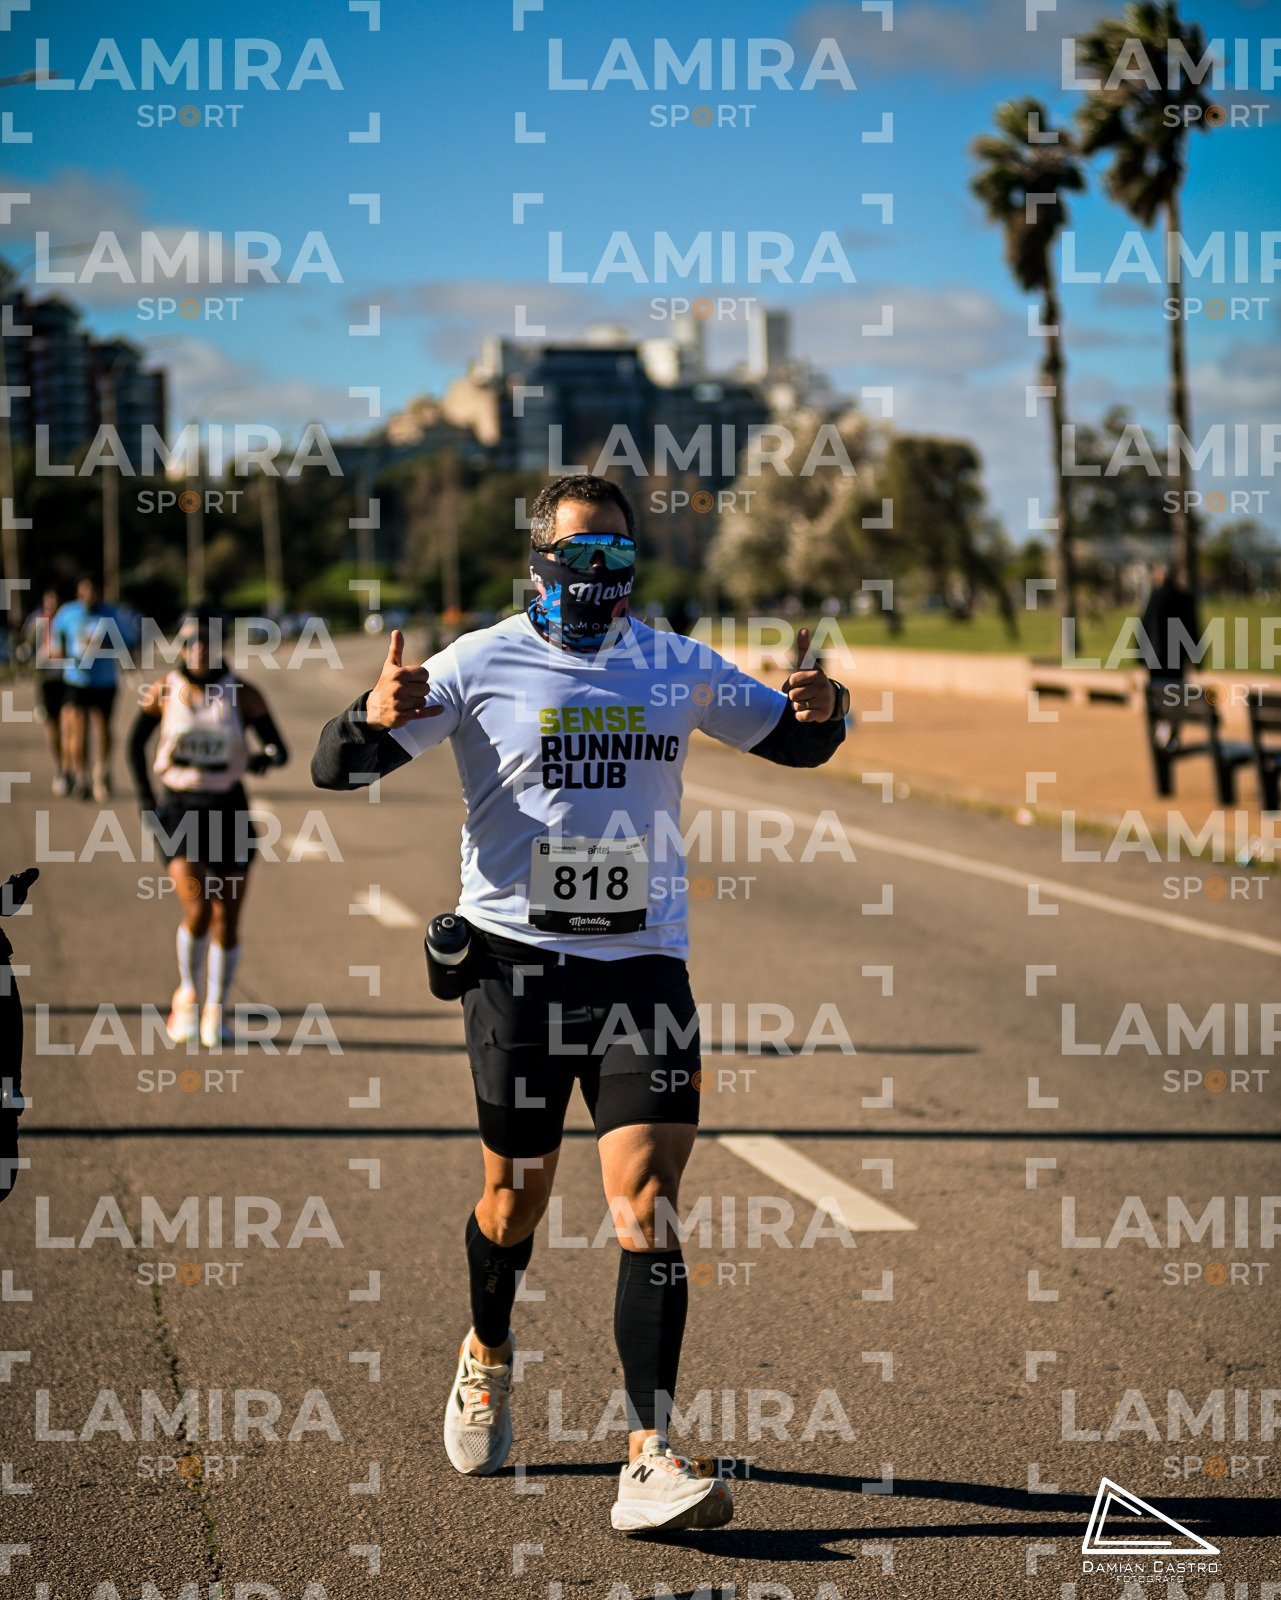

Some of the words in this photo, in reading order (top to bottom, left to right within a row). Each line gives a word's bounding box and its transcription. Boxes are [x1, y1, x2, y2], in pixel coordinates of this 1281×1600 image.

[538, 705, 647, 735] SENSE
[540, 733, 680, 763] RUNNING
[541, 761, 627, 790] CLUB
[553, 865, 629, 901] 818
[569, 916, 611, 927] Maratón
[631, 1465, 655, 1484] N
